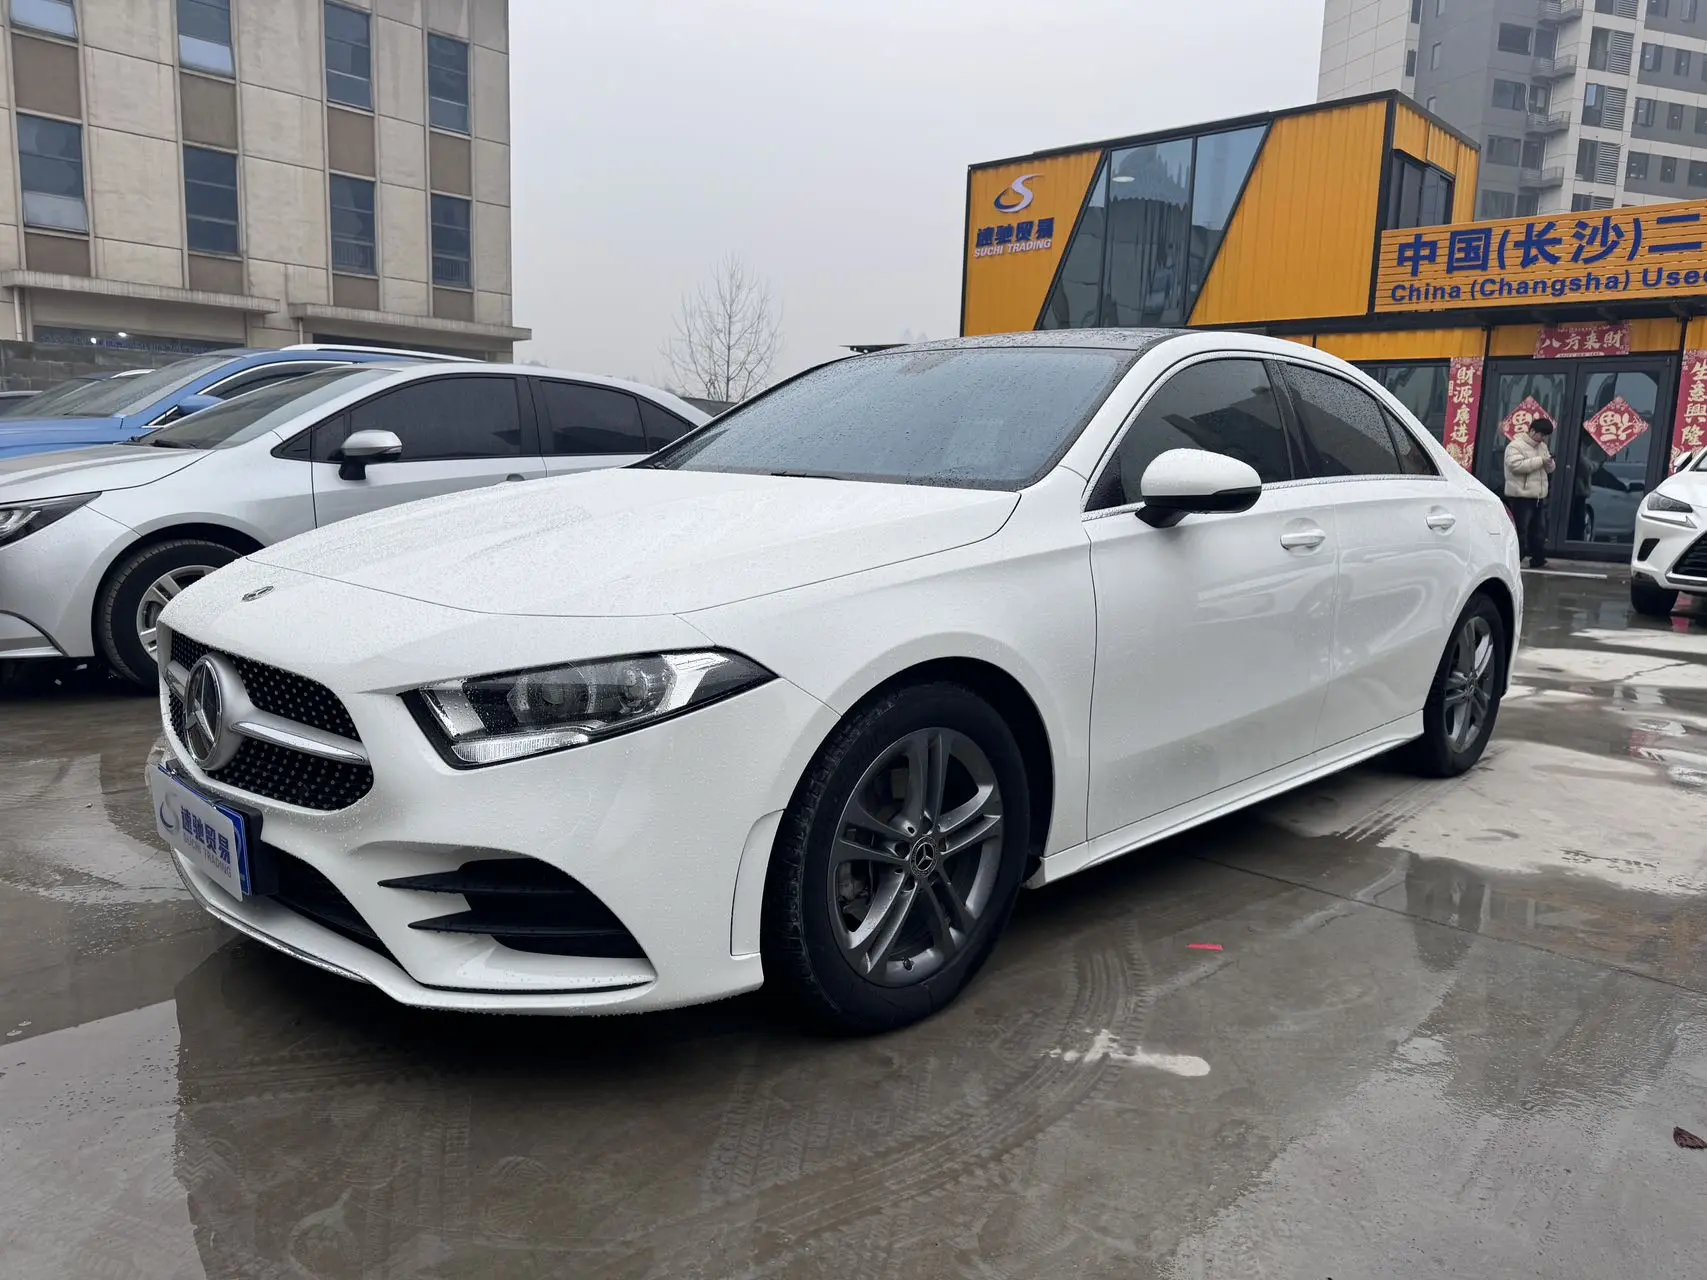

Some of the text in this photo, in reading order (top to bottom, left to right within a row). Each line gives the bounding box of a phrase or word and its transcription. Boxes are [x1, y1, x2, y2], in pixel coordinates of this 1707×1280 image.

[975, 239, 1052, 258] SUCHI TRADING
[1397, 213, 1702, 277] 中国(长沙)二
[1391, 282, 1462, 302] China
[1471, 270, 1631, 300] (Changsha)
[1599, 411, 1636, 442] 福
